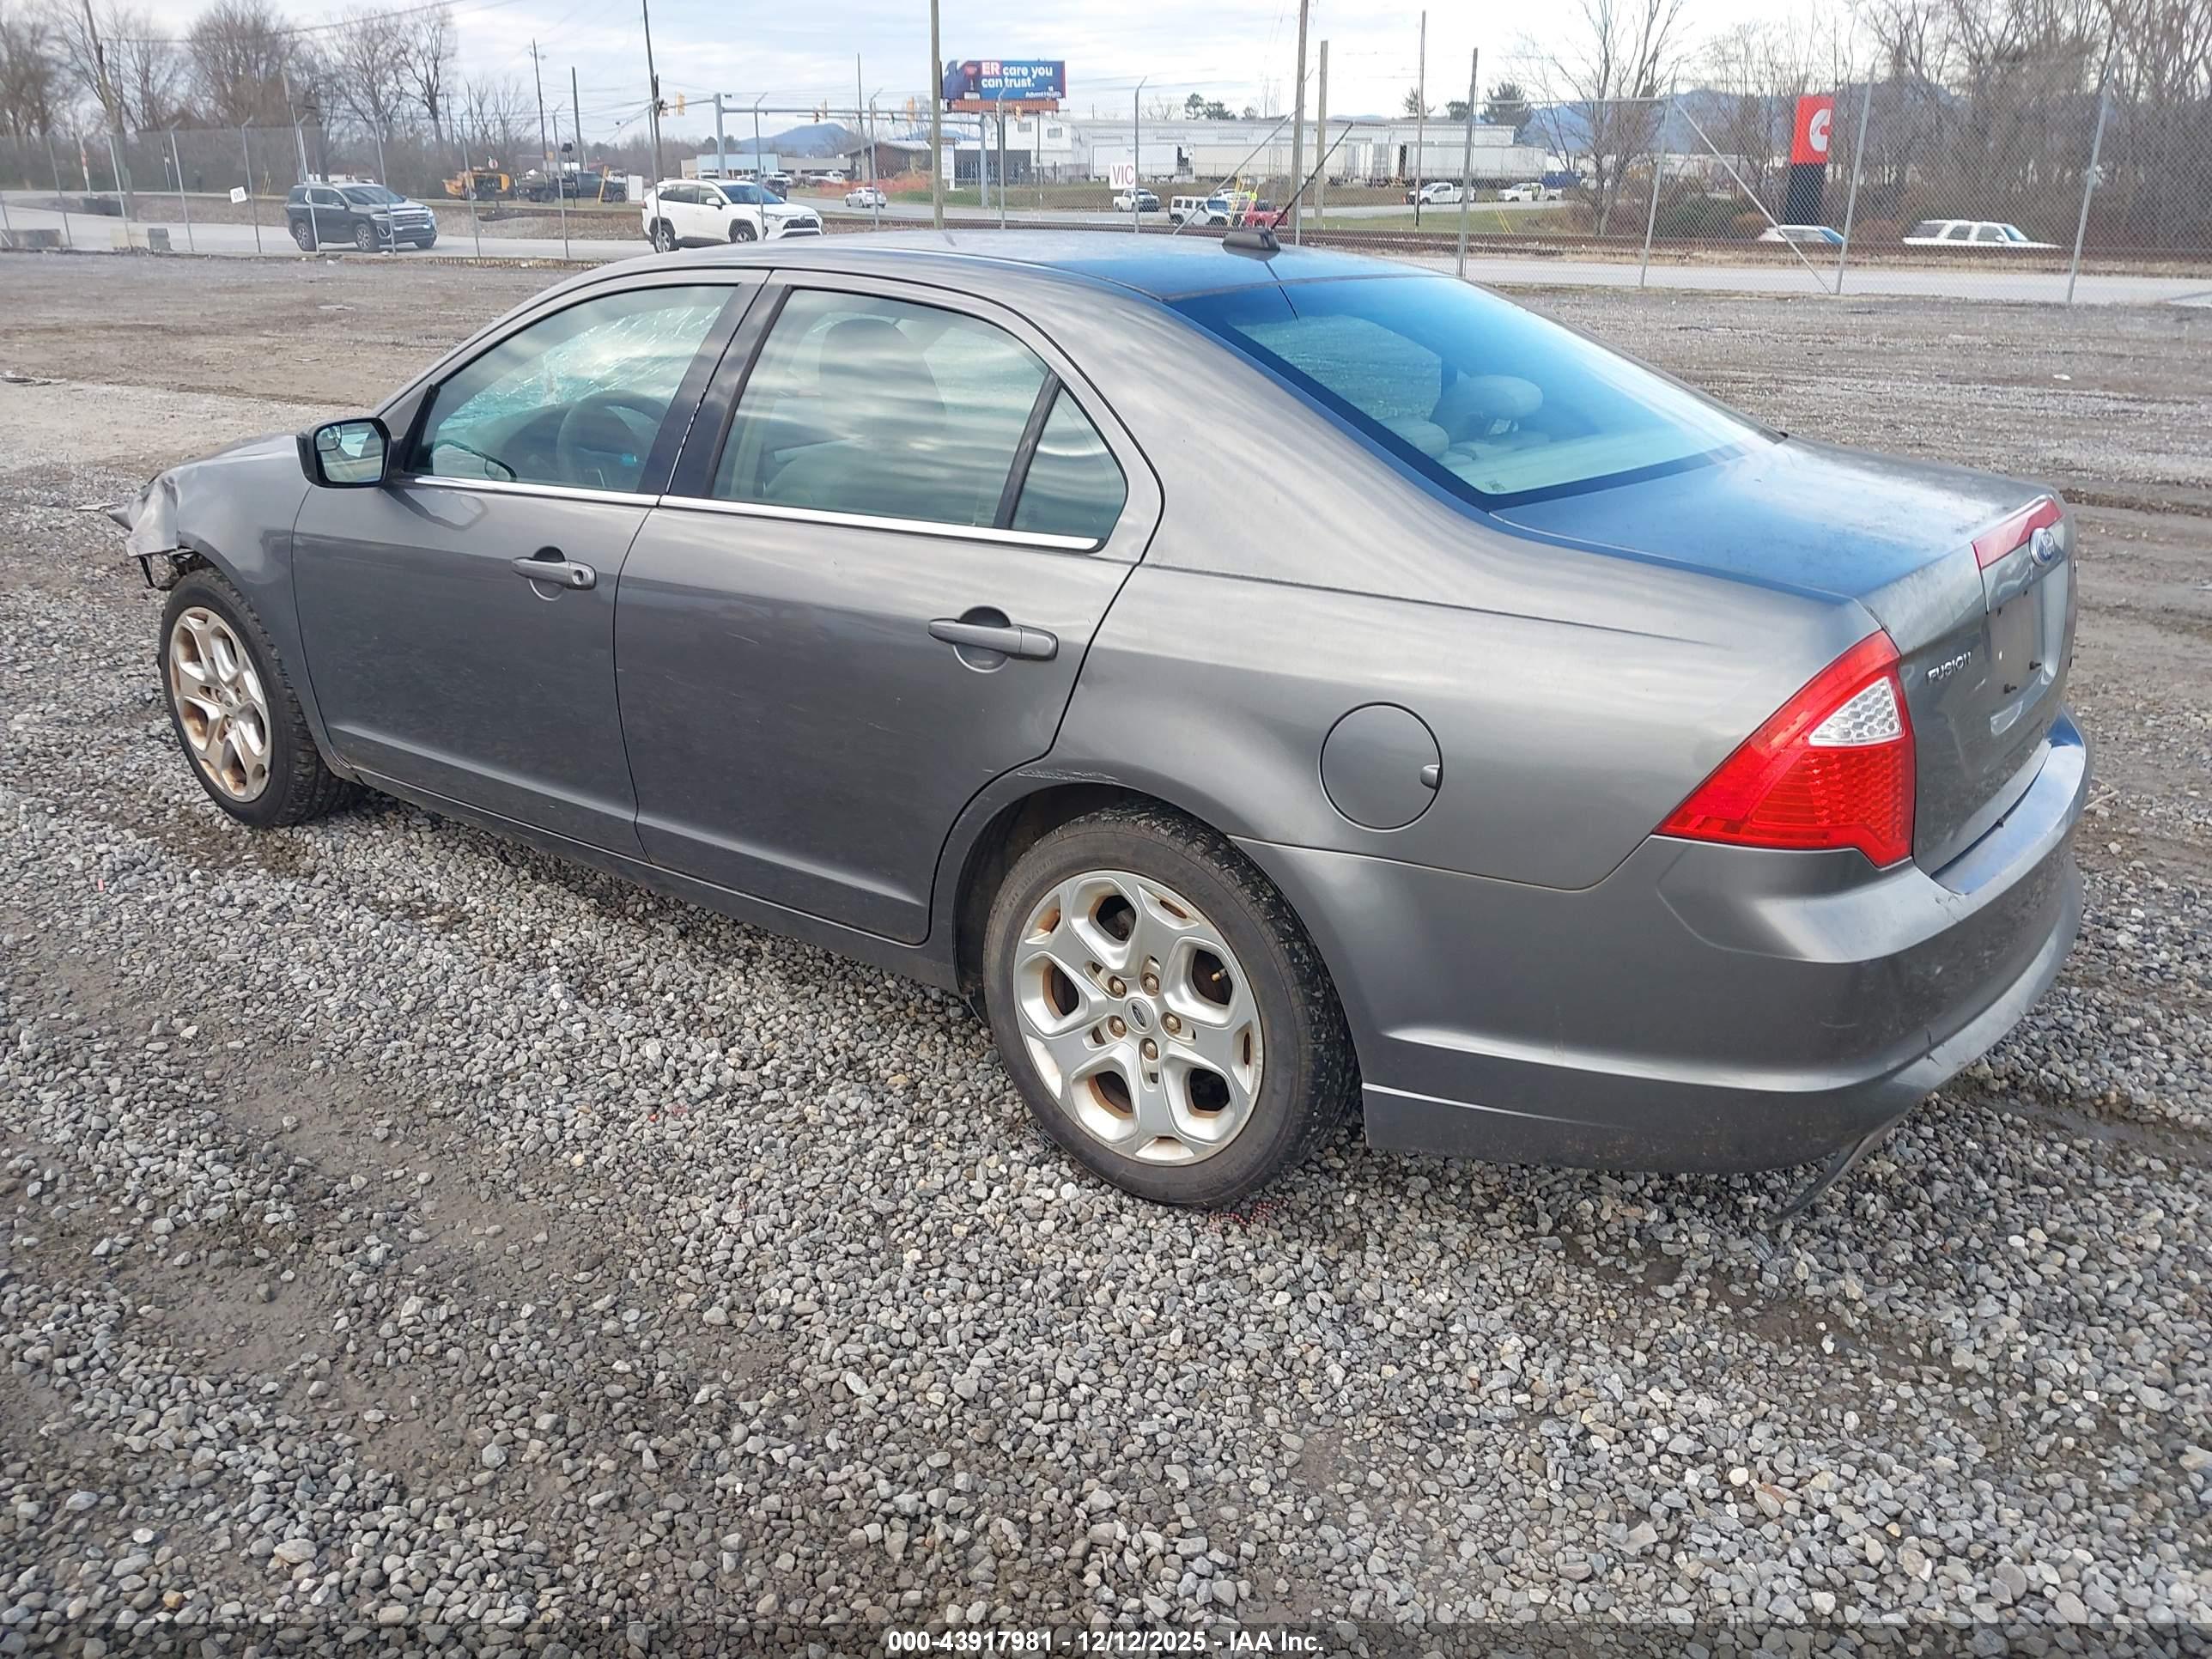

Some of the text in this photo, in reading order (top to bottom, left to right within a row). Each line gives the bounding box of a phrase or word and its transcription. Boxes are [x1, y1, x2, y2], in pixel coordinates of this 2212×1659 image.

[981, 62, 1053, 79] ER care you
[981, 76, 1035, 88] can trust.
[1112, 164, 1134, 185] VIC
[1927, 651, 1972, 684] FUSION
